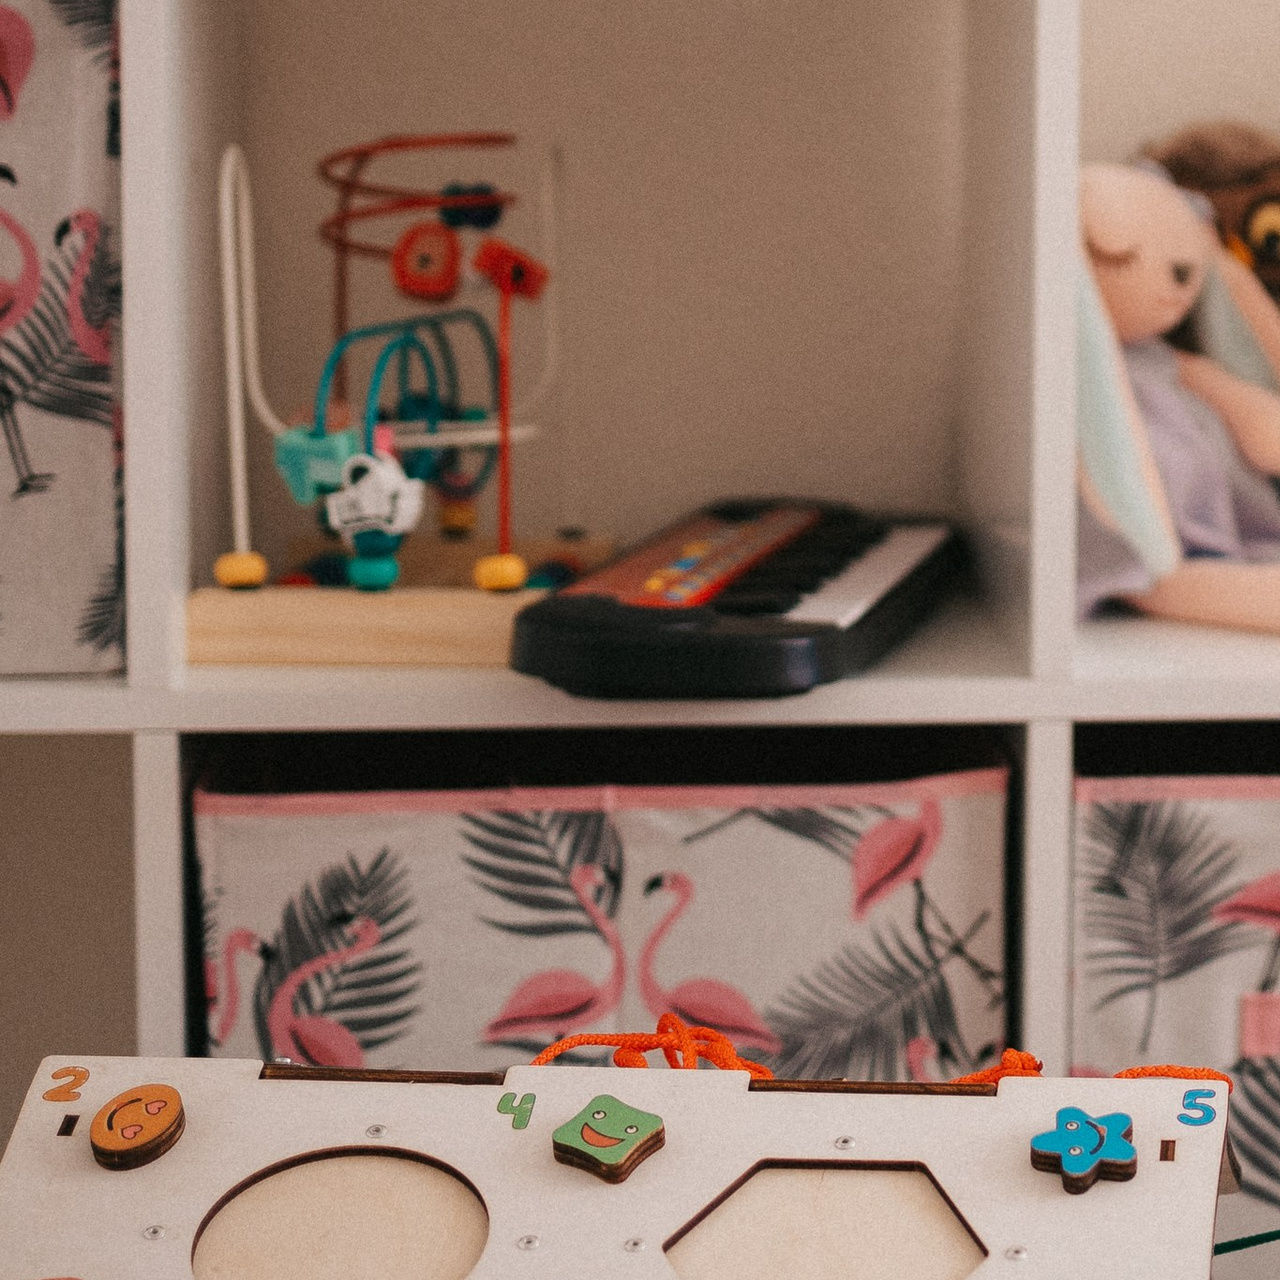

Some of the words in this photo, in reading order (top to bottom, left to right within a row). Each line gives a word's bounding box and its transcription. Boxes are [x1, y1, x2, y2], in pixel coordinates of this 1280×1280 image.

[42, 1066, 90, 1102] 2
[497, 1092, 536, 1130] 4
[1177, 1089, 1216, 1126] 5
